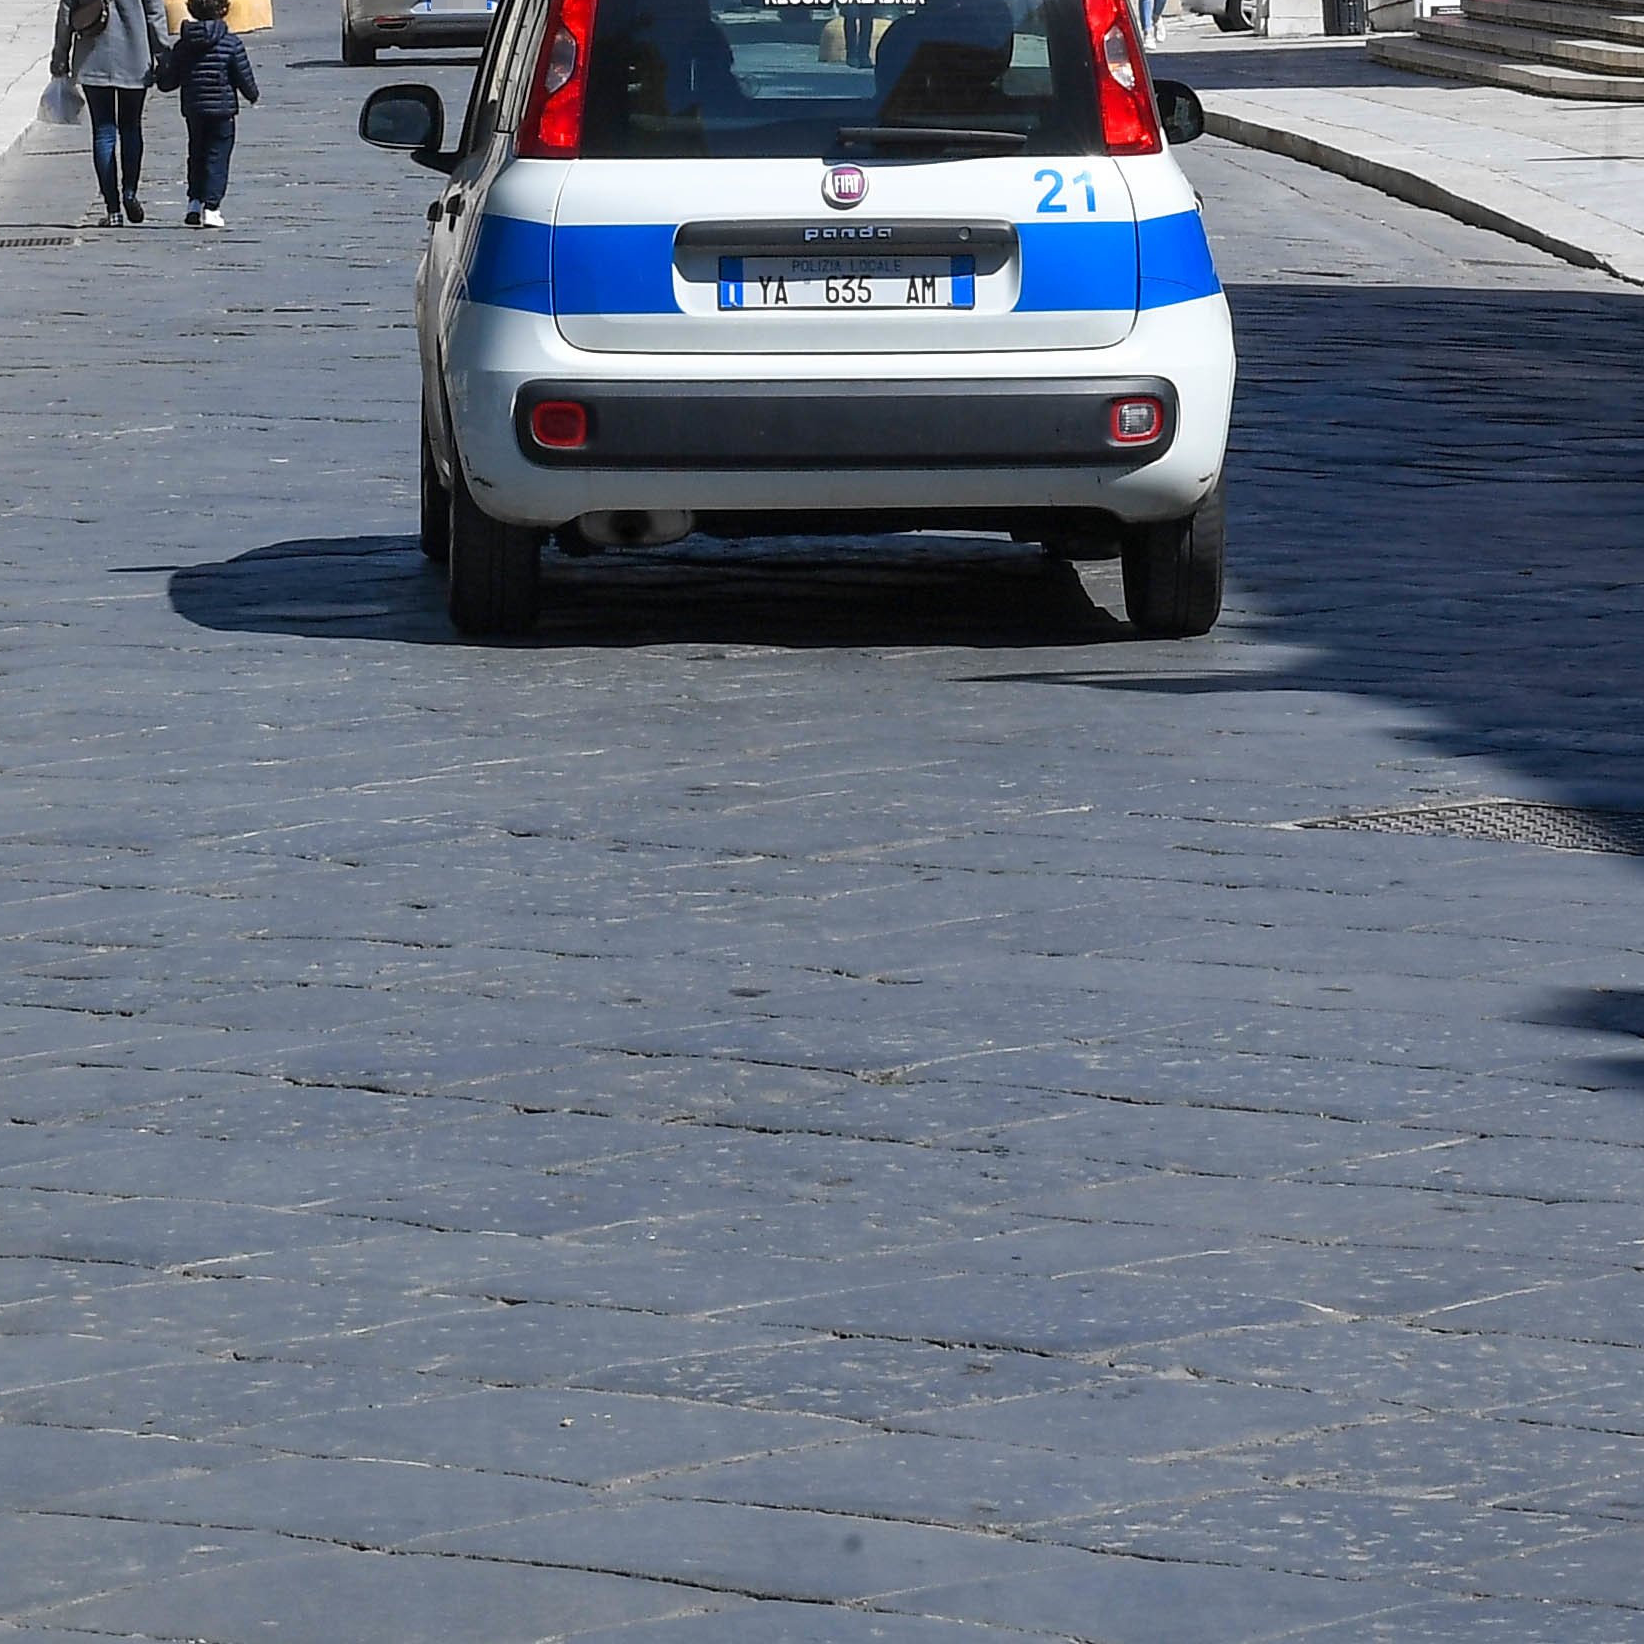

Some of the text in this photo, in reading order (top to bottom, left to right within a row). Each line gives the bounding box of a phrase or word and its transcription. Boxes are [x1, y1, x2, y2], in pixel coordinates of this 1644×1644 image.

[833, 173, 860, 196] FIAT
[1033, 168, 1098, 214] 21
[803, 225, 893, 242] panda
[791, 259, 902, 273] POLIZIA LOCALE
[759, 275, 937, 306] YA 635 AM
